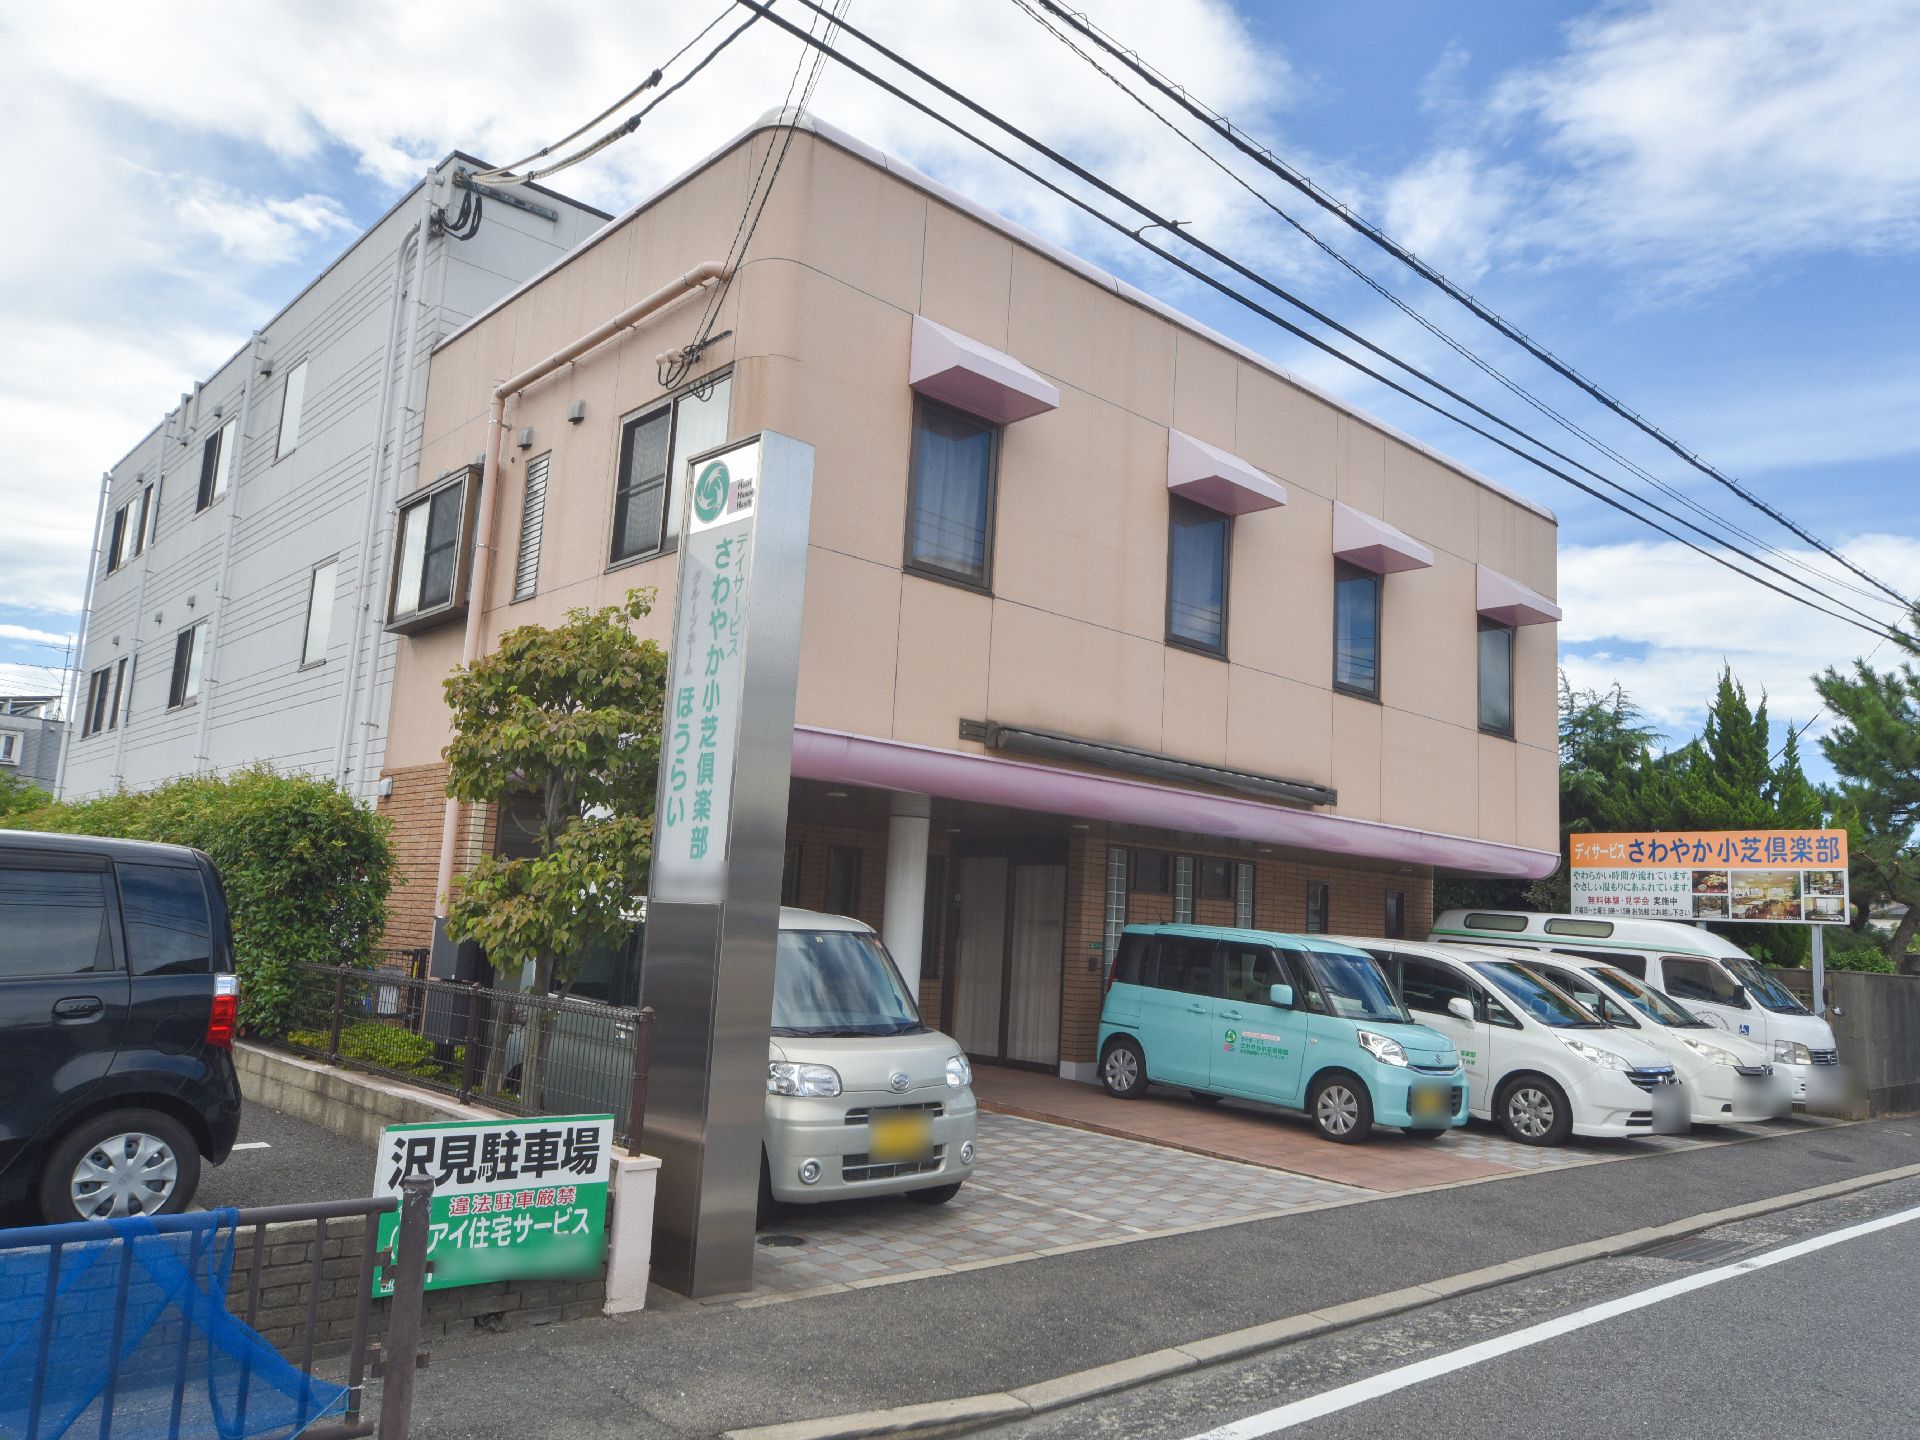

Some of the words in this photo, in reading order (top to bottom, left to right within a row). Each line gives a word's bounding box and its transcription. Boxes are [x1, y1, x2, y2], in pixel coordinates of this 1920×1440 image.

[728, 533, 750, 657] デイサービス
[689, 537, 734, 861] さわやか小芝倶楽部
[667, 686, 695, 829] ほうらい
[1628, 835, 1841, 863] さわやか小芝倶楽部
[388, 1127, 600, 1191] 沢見駐車場
[448, 1185, 577, 1217] 違法駐車厳禁
